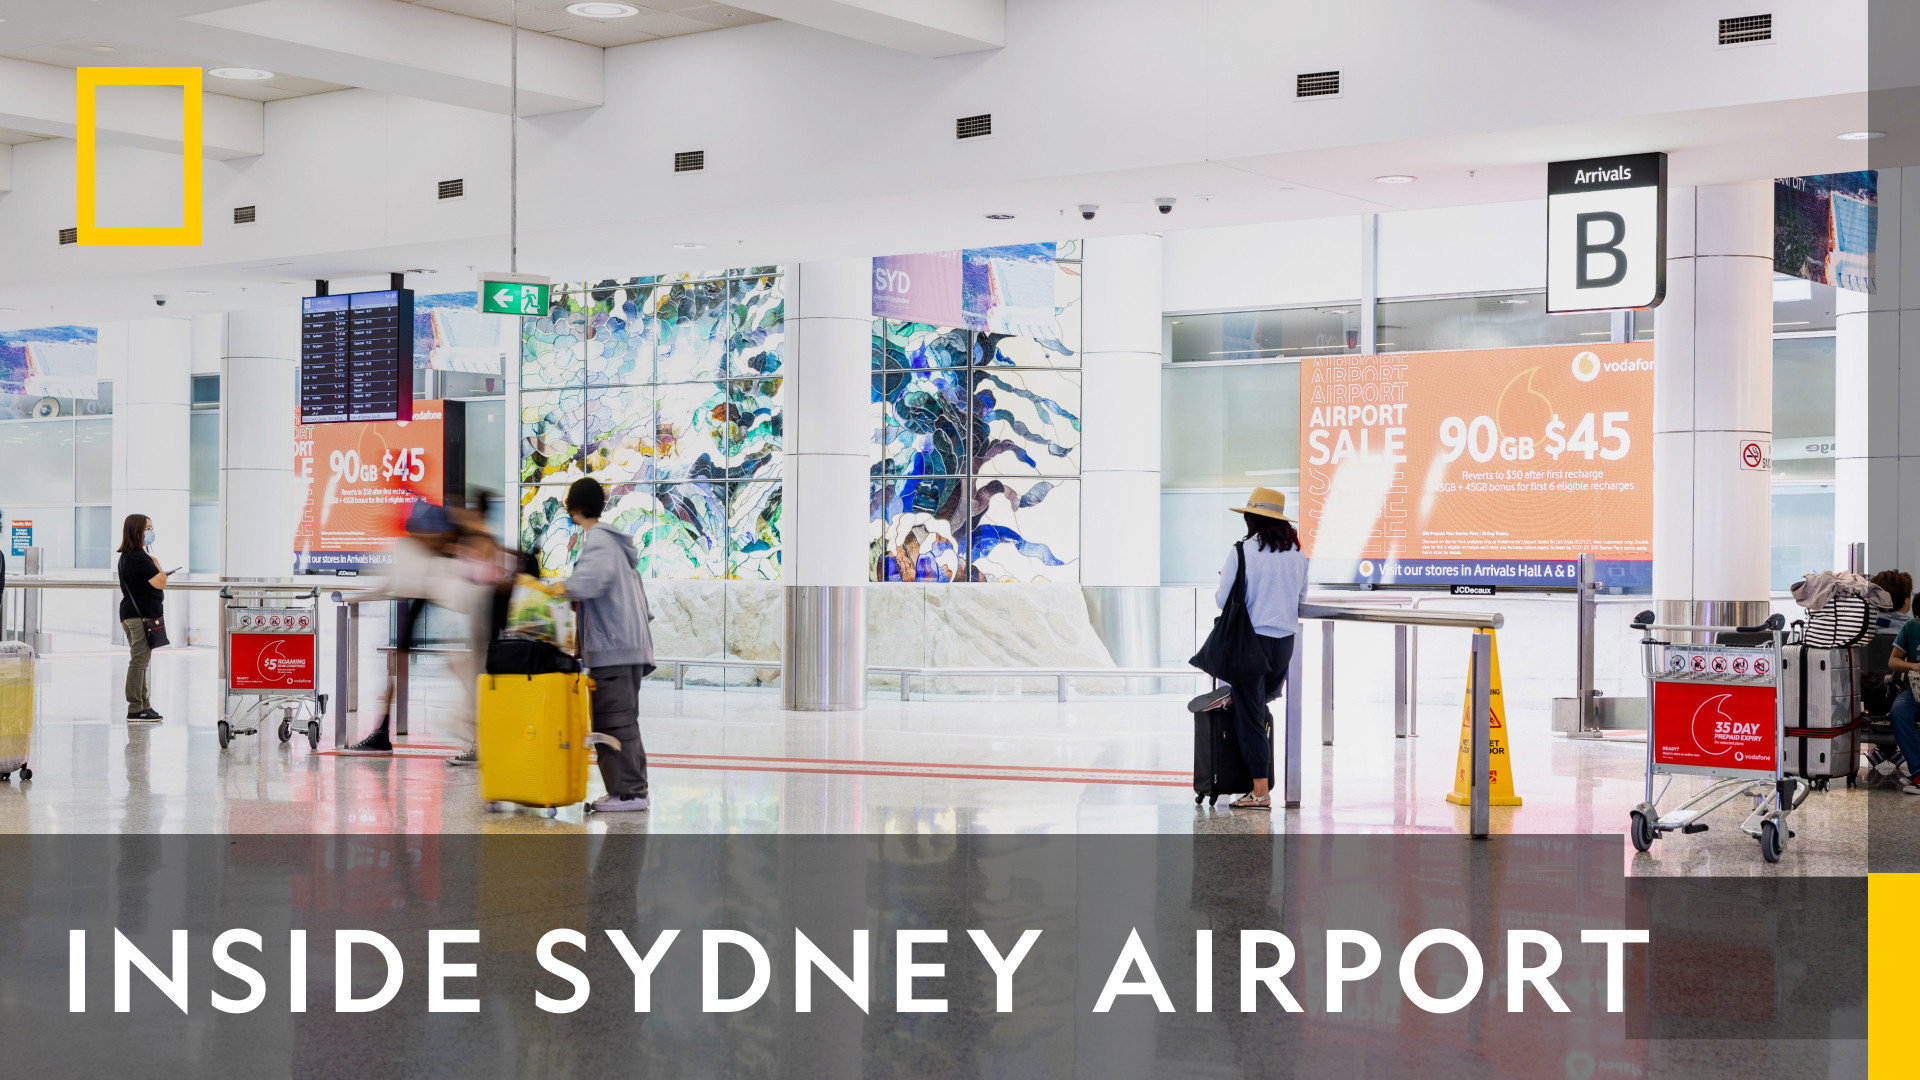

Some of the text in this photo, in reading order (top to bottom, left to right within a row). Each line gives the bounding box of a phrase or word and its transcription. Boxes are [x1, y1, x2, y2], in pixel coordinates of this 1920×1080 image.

[1574, 165, 1632, 184] Arrivals
[1576, 211, 1628, 289] B
[876, 267, 911, 294] SYD
[1603, 357, 1654, 372] vodafo
[1309, 404, 1408, 427] AIRPORT
[1545, 411, 1631, 461] $45
[1309, 428, 1408, 466] SALE
[382, 447, 425, 482] $45
[1462, 469, 1604, 481] Reverts to $50 after first recharge
[1434, 482, 1456, 492] 5GB
[1465, 482, 1488, 492] 45GB
[1489, 482, 1516, 492] bonus
[1517, 481, 1530, 491] for
[1531, 481, 1547, 491] first
[1549, 482, 1555, 490] 6
[1557, 481, 1588, 492] eligible
[1590, 481, 1635, 492] recharges
[1404, 566, 1423, 576] our
[1425, 565, 1459, 576] stores
[1461, 564, 1471, 577] in
[1475, 564, 1516, 577] Arrivals
[1519, 564, 1542, 577] Hall
[1544, 566, 1553, 577] A
[1555, 566, 1565, 577] &
[1567, 566, 1576, 578] B
[1454, 586, 1492, 595] JCDecaux
[264, 657, 278, 670] $5
[1714, 721, 1761, 735] 35 DAY
[1714, 733, 1740, 741] PREPAID
